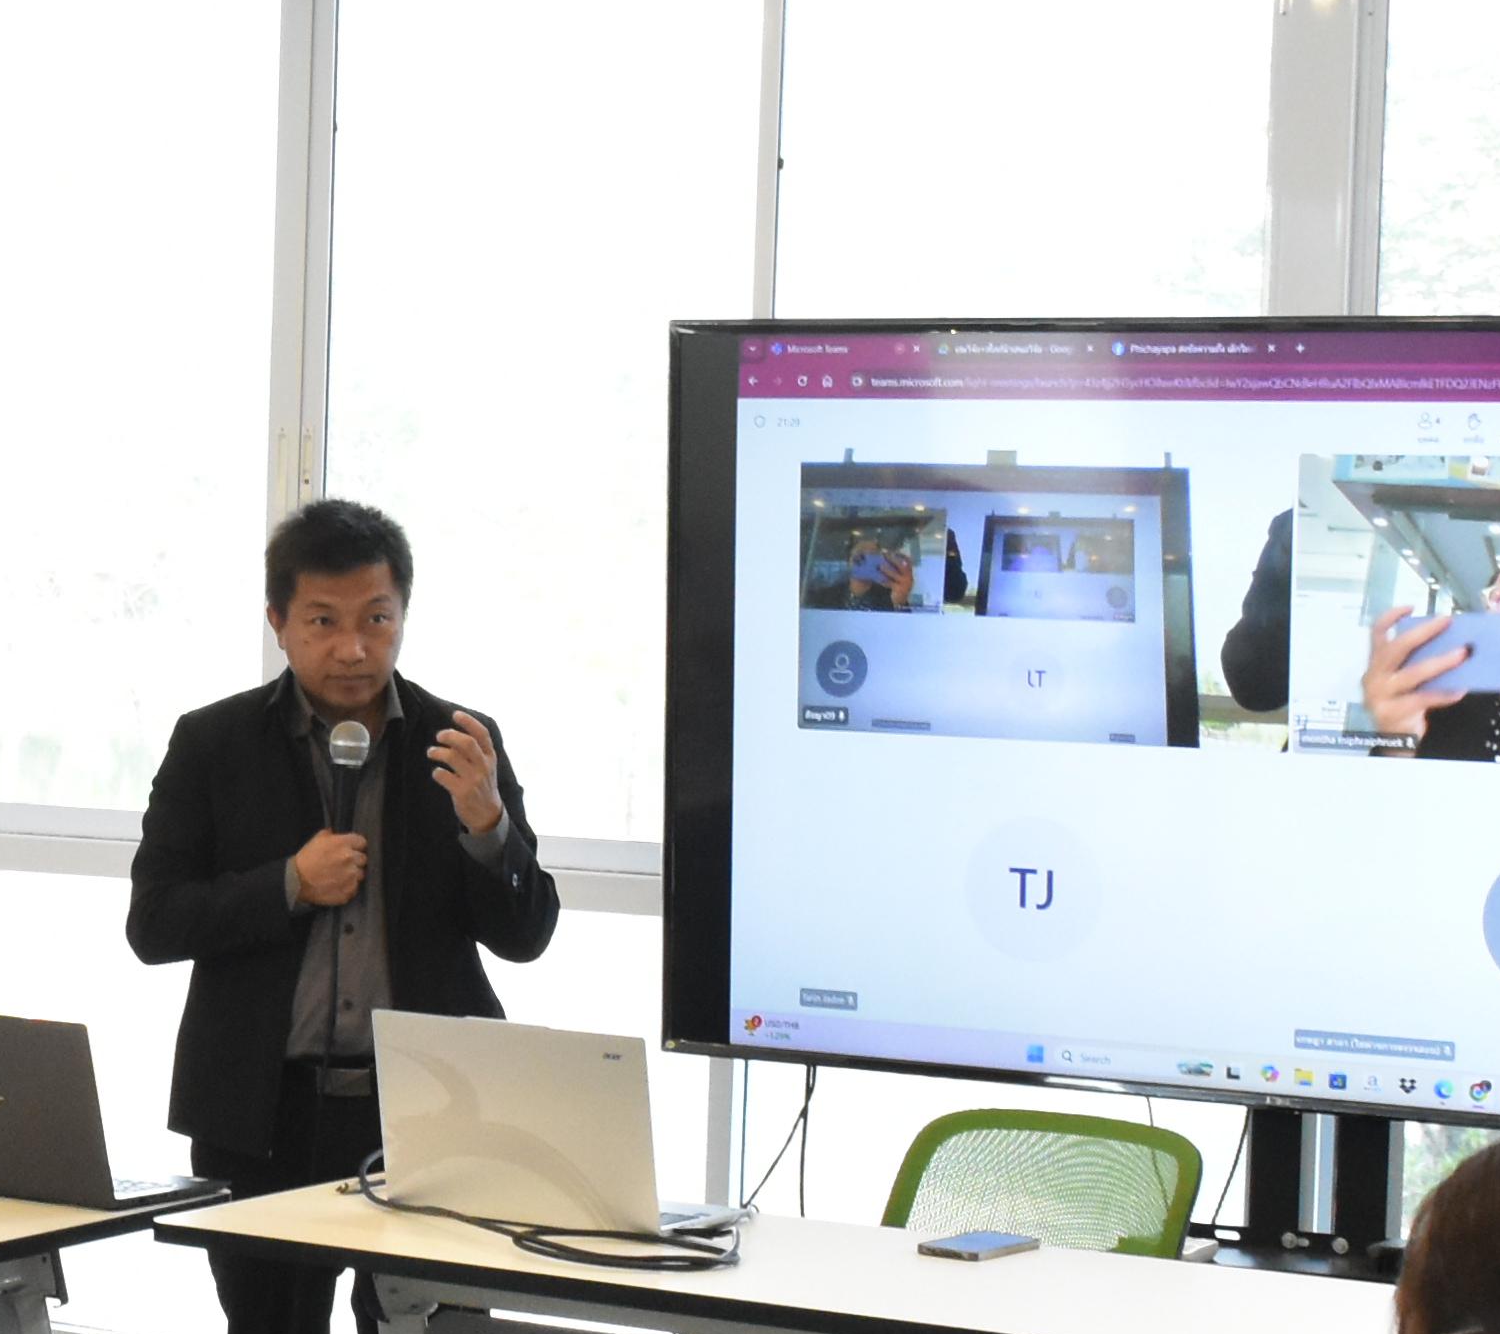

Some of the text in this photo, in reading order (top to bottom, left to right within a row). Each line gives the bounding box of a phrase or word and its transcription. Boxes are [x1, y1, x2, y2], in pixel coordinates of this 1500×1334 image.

[787, 344, 849, 354] Microsoft Teams
[1008, 867, 1054, 910] TJ
